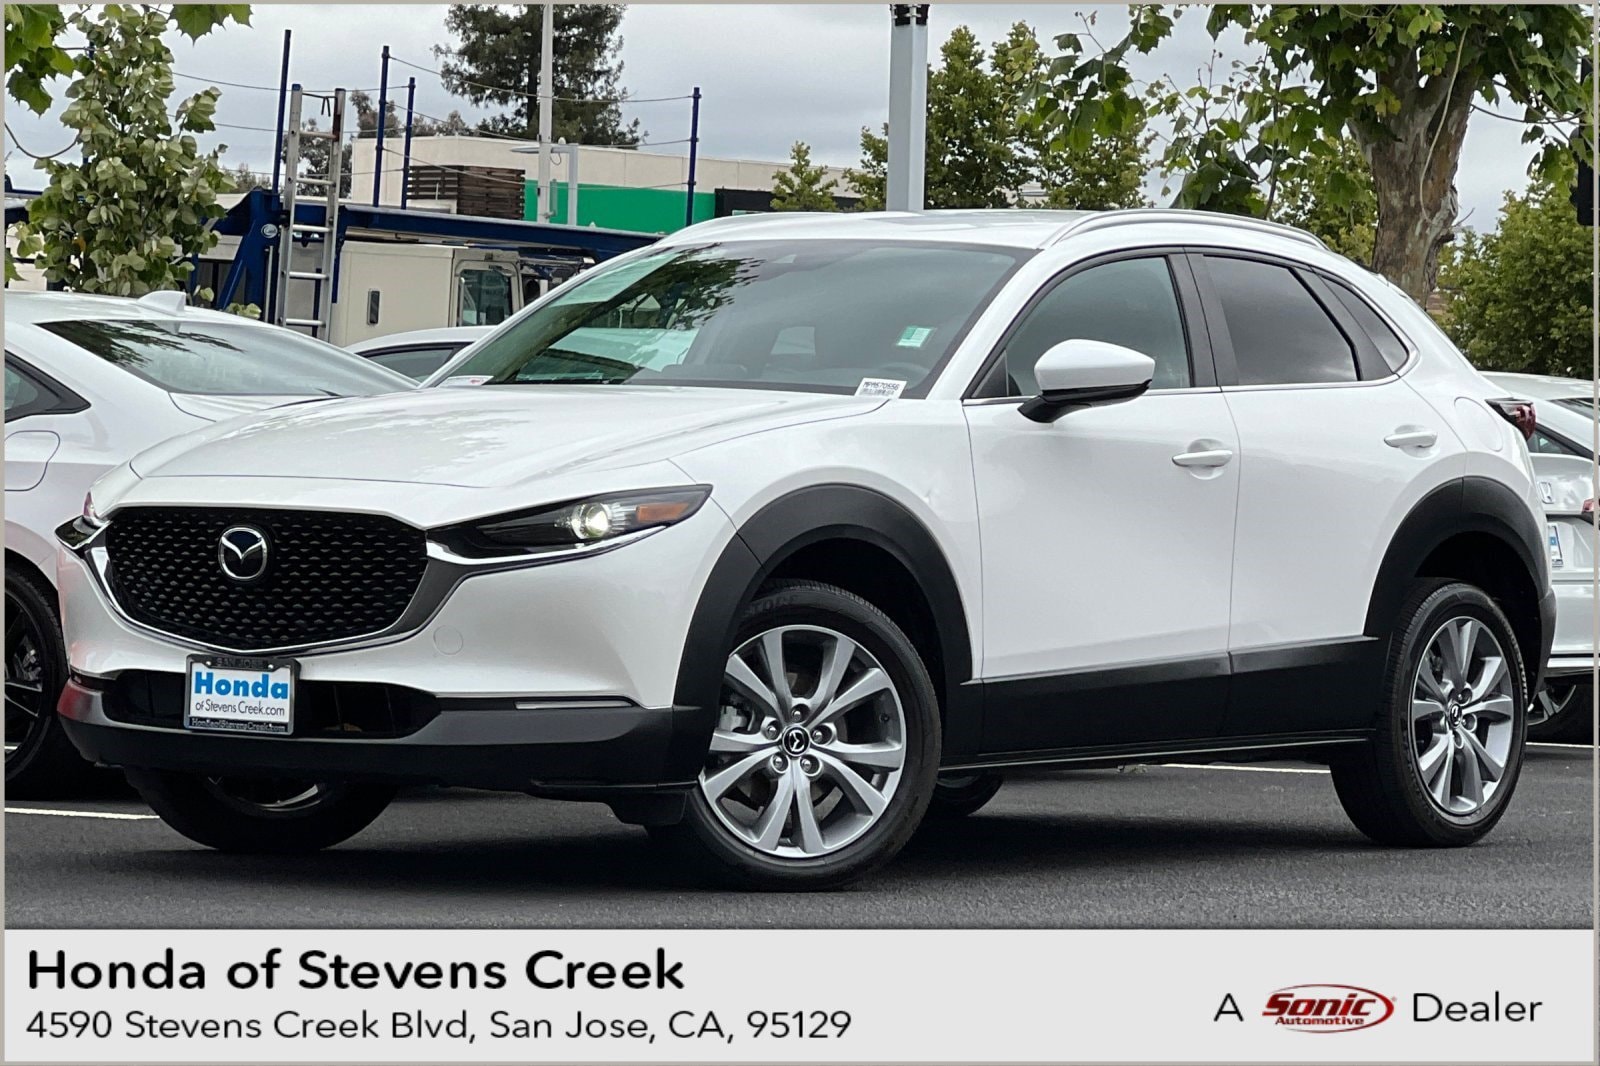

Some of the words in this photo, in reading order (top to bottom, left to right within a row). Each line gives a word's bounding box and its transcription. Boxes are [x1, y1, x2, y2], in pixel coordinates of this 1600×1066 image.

[194, 671, 289, 700] Honda
[195, 700, 204, 711] of
[205, 698, 237, 713] Stevens
[238, 700, 285, 716] Creek.com
